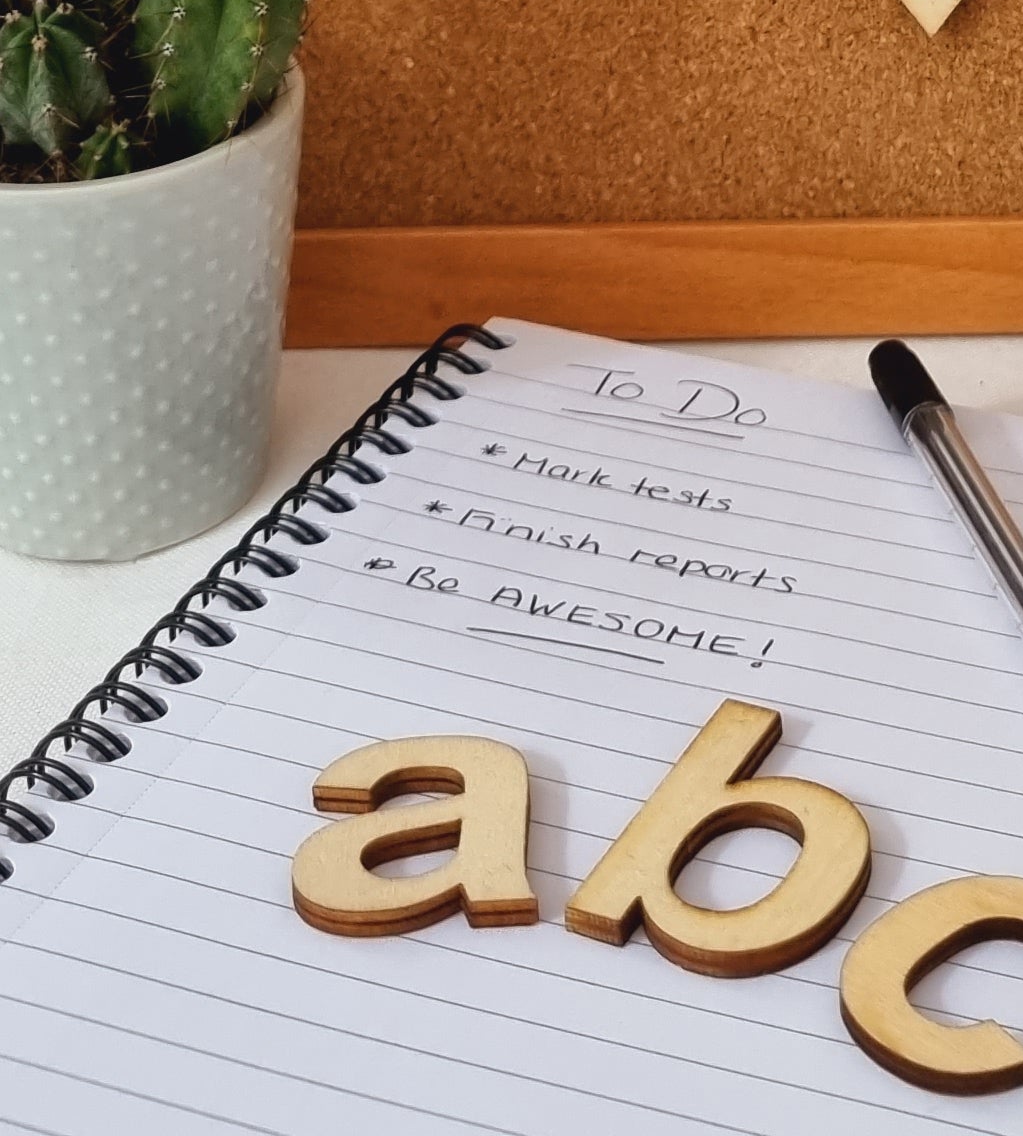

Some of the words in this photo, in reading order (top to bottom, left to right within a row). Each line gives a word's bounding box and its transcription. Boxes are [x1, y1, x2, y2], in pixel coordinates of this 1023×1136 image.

[567, 363, 644, 400] To
[660, 379, 768, 427] Do
[512, 452, 612, 488] Mark
[630, 477, 733, 512] tests
[404, 565, 460, 594] Be
[458, 508, 600, 555] Finish
[629, 548, 798, 595] reports
